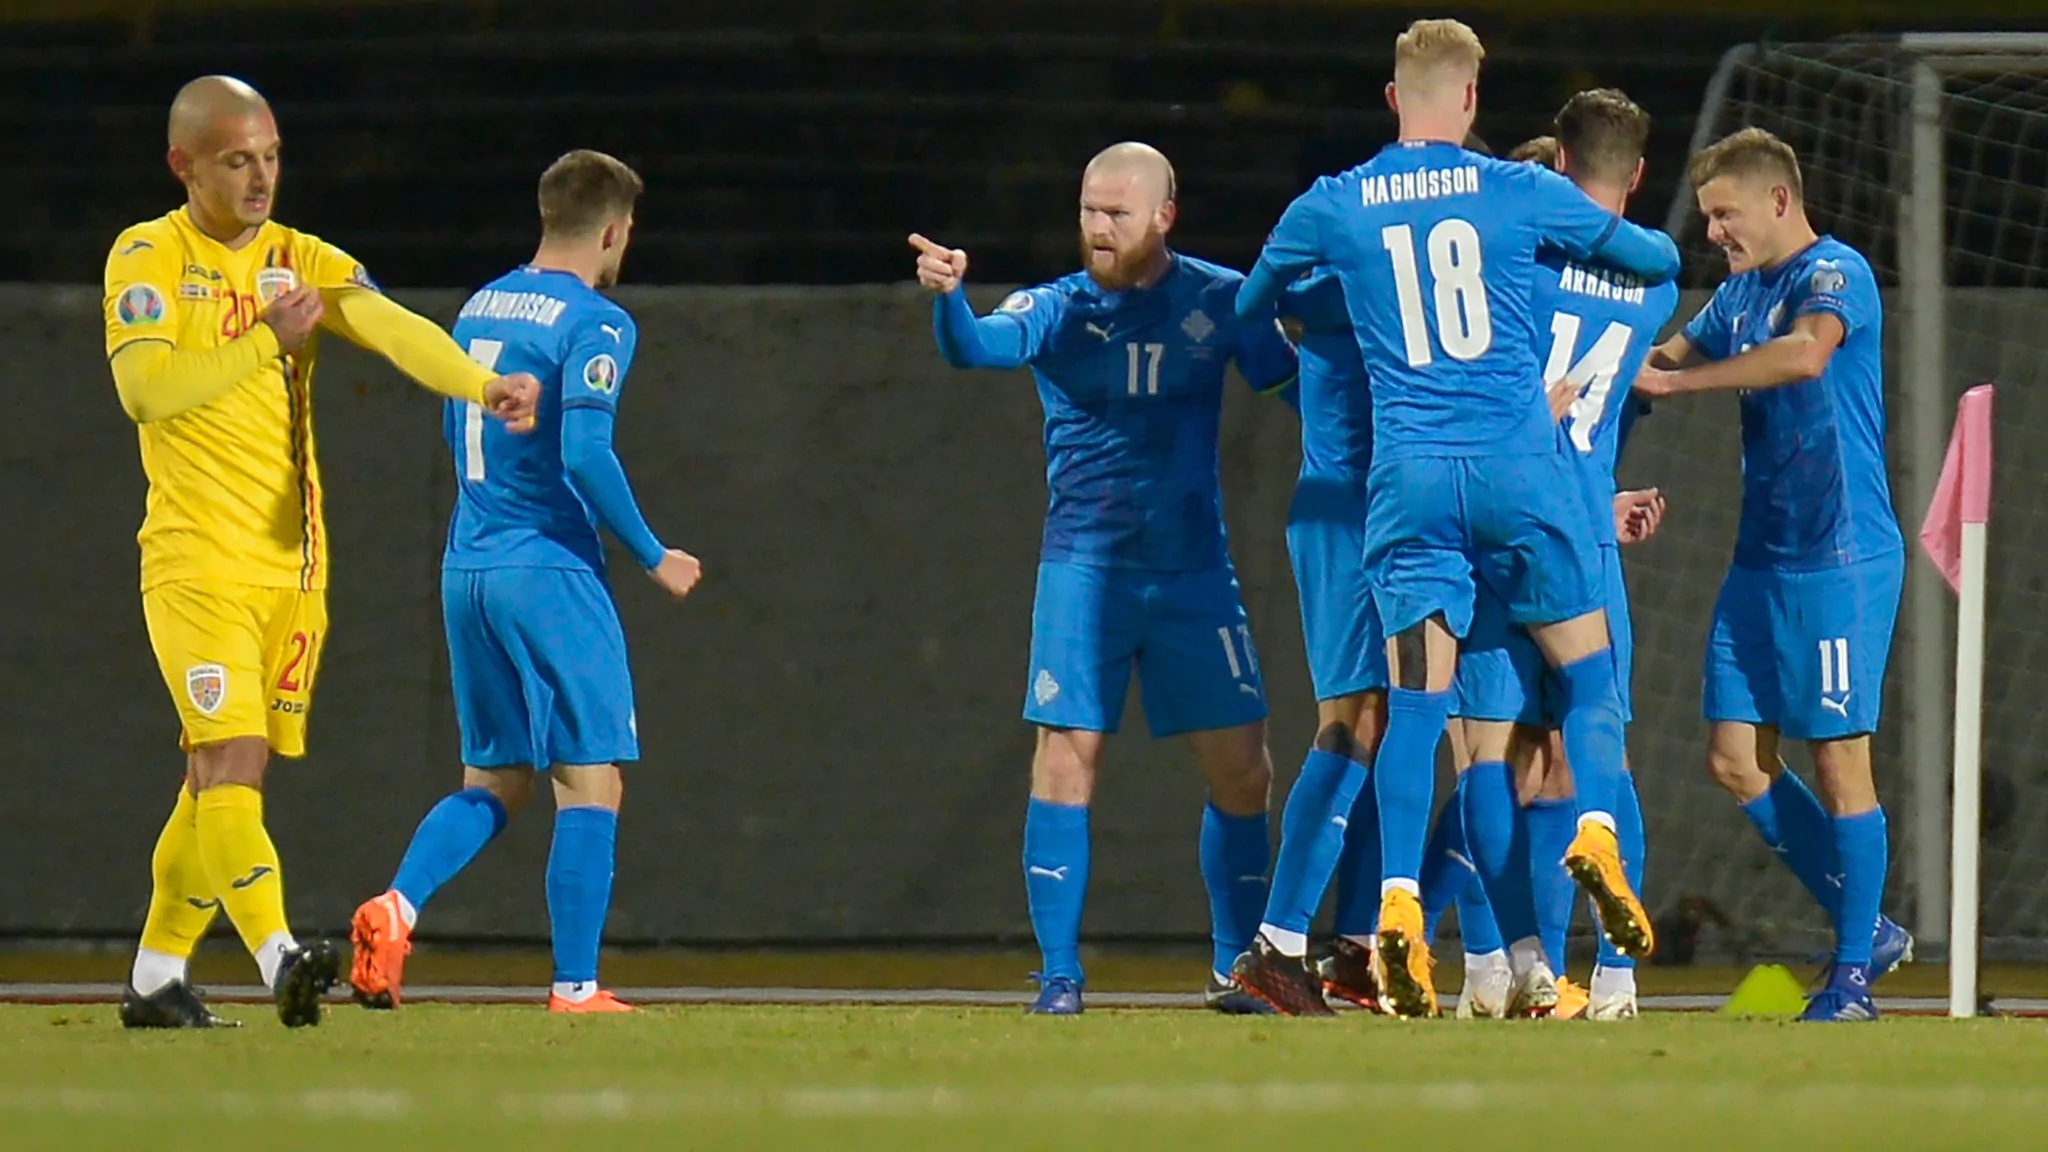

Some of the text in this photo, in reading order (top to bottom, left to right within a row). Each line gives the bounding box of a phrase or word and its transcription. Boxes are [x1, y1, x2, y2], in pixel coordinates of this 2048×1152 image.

[1361, 166, 1479, 207] MAGNÚSSON
[1382, 218, 1491, 368] 18
[1126, 342, 1164, 395] 17
[1543, 311, 1632, 452] 14
[1818, 637, 1850, 692] 11
